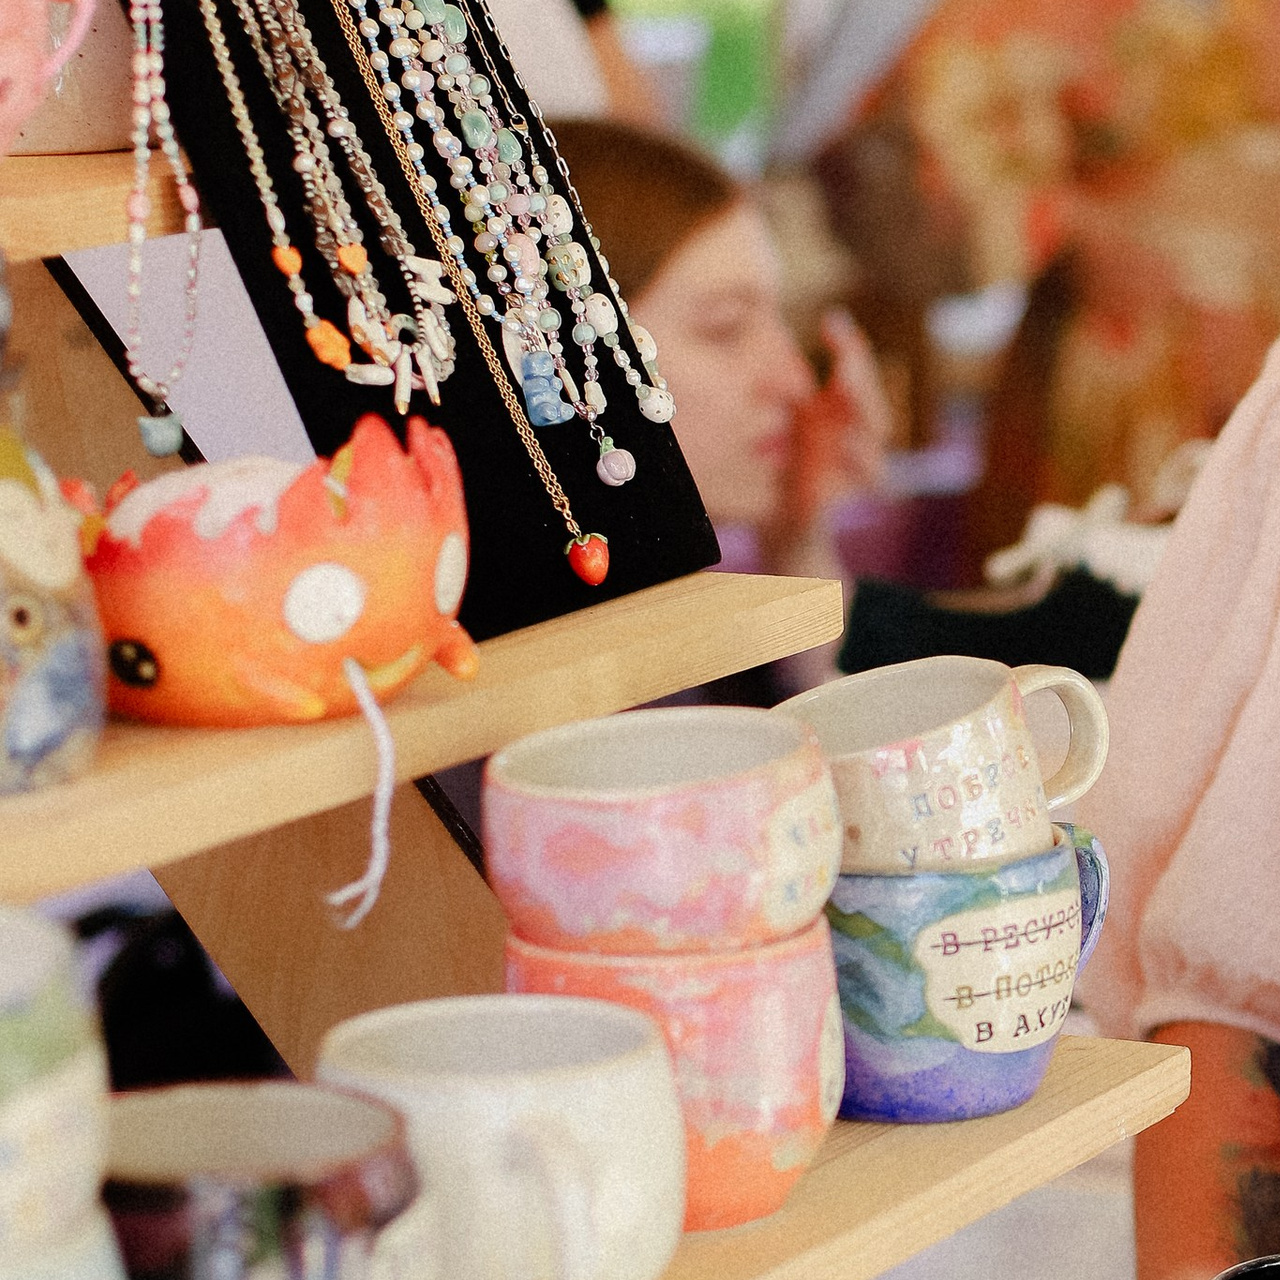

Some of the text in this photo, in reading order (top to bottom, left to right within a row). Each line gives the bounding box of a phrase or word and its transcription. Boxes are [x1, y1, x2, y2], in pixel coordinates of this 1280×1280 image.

[941, 932, 960, 956] В
[956, 949, 1079, 1011] В ПОТОК
[976, 1021, 994, 1043] В
